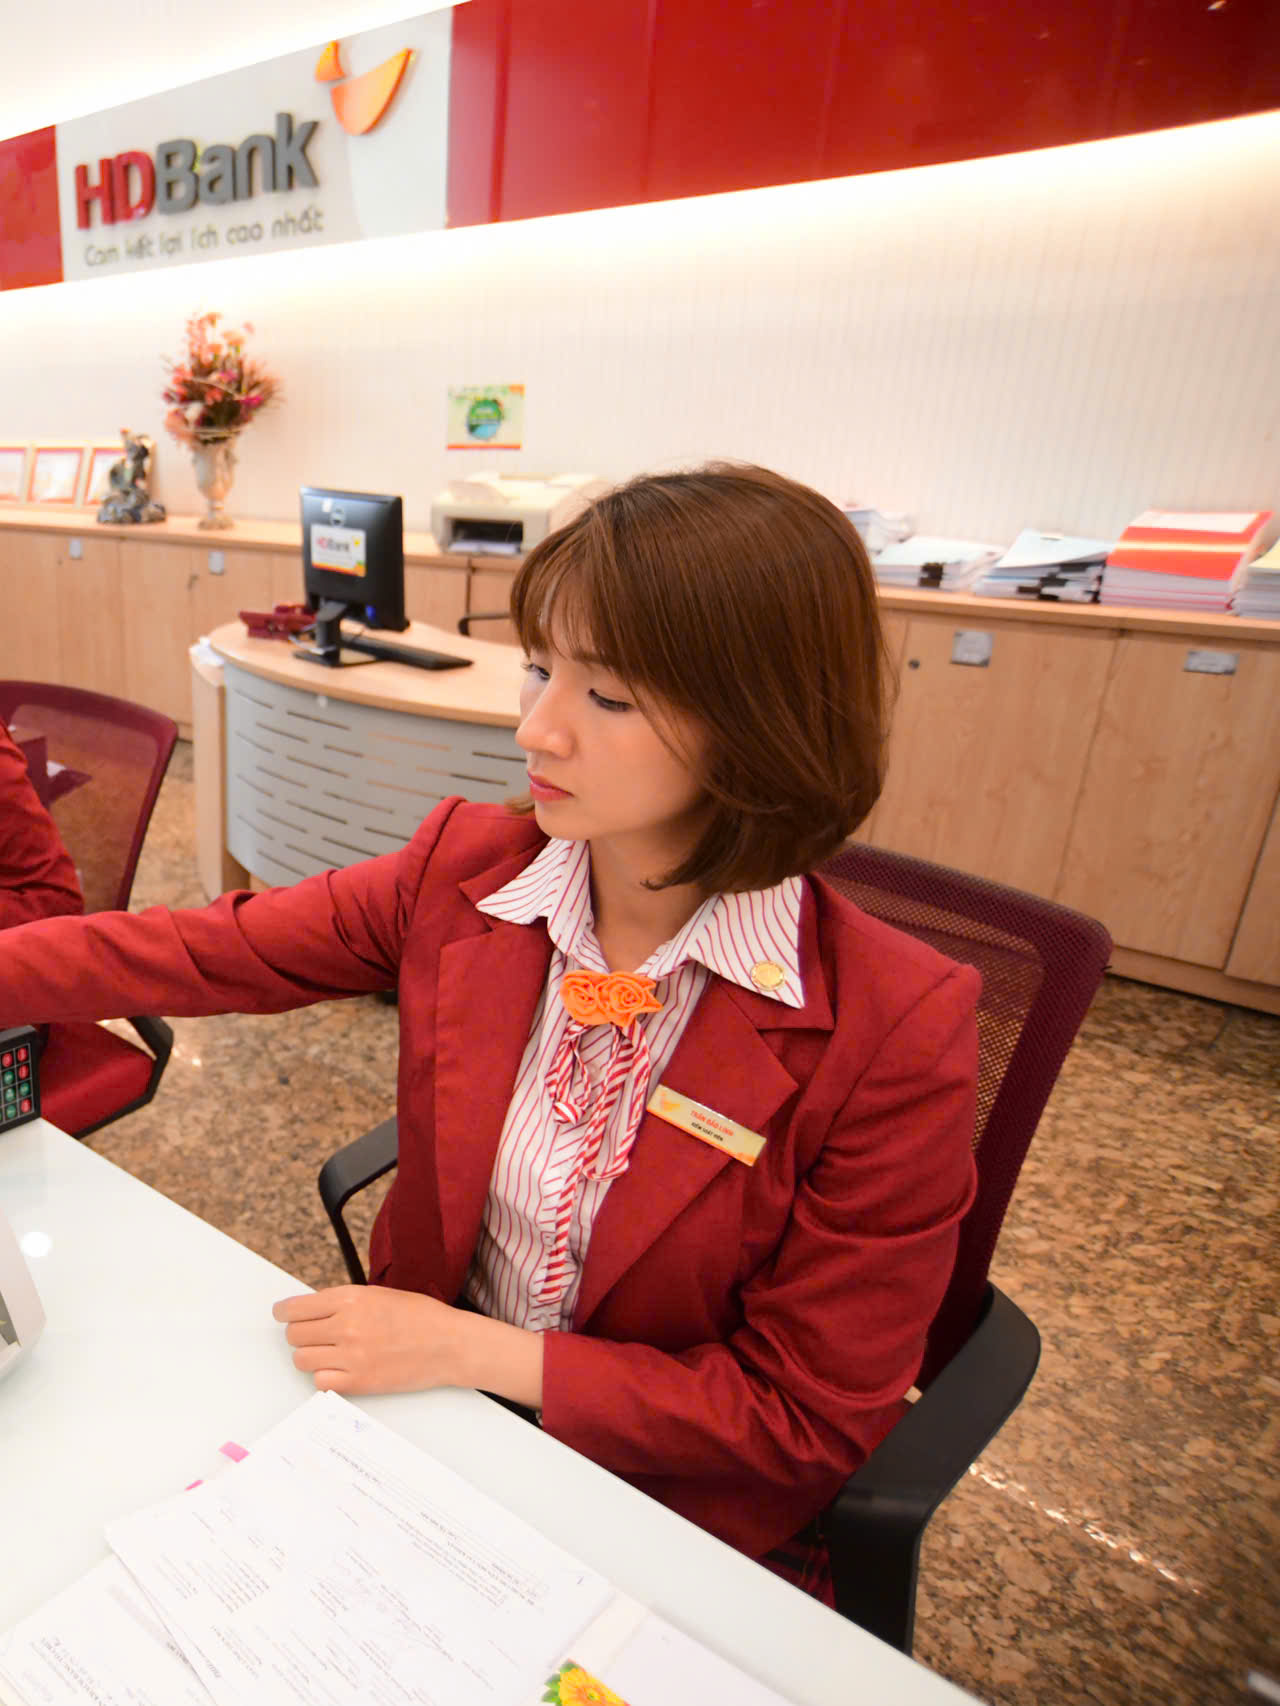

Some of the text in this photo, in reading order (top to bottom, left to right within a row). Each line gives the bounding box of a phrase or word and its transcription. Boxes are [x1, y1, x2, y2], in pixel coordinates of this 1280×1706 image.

[74, 112, 320, 230] HDBank
[84, 243, 120, 267] Cam
[225, 222, 264, 246] cao
[271, 204, 325, 239] nhất
